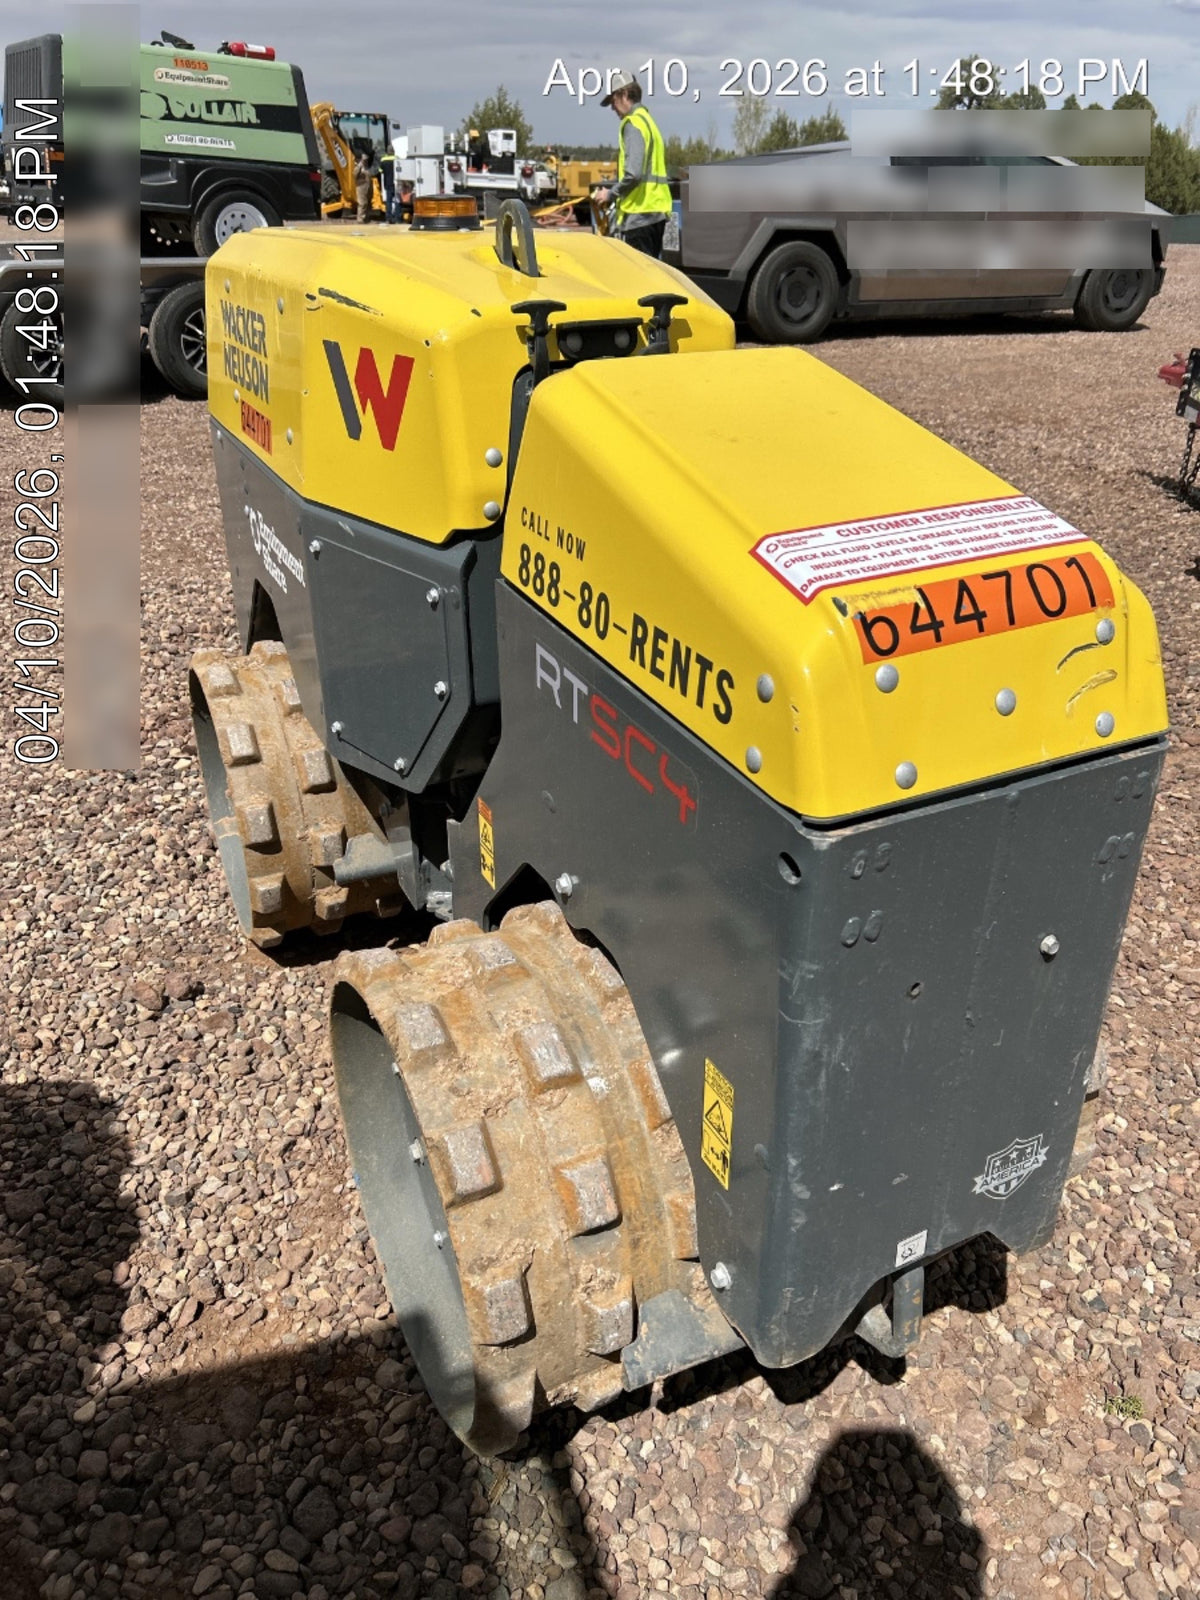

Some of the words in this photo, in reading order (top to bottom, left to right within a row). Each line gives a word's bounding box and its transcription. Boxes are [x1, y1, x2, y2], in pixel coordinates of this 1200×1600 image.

[220, 299, 268, 359] WACKER
[223, 341, 270, 405] NEUSON
[521, 506, 550, 542] CALL
[556, 526, 586, 562] NOW
[784, 552, 821, 569] CHECK
[821, 549, 842, 560] ALL
[842, 543, 871, 555] FLUID
[871, 537, 908, 550] LEVELS
[917, 529, 954, 542] GREASE
[954, 524, 982, 535] DAILY
[981, 518, 1018, 530] BEFORE
[1018, 514, 1045, 524] START
[810, 554, 872, 571] INSURANCE
[880, 549, 905, 559] FLAT
[905, 543, 932, 555] TIRES
[939, 537, 962, 548] TIRE
[962, 531, 1003, 544] DAMAGE
[1008, 523, 1058, 536] REFUELING
[836, 518, 921, 538] CUSTOMER
[922, 499, 1039, 523] RESPONSIBILITY
[800, 570, 846, 593] DAMAGE
[846, 568, 860, 577] TO
[860, 557, 919, 574] EQUIPMENT
[926, 548, 970, 562] BATTERY
[969, 535, 1039, 554] MAINTENANCE
[518, 543, 735, 725] 888-80-RENTS
[859, 557, 1097, 657] 644701
[979, 1155, 1041, 1190] AMERICA
